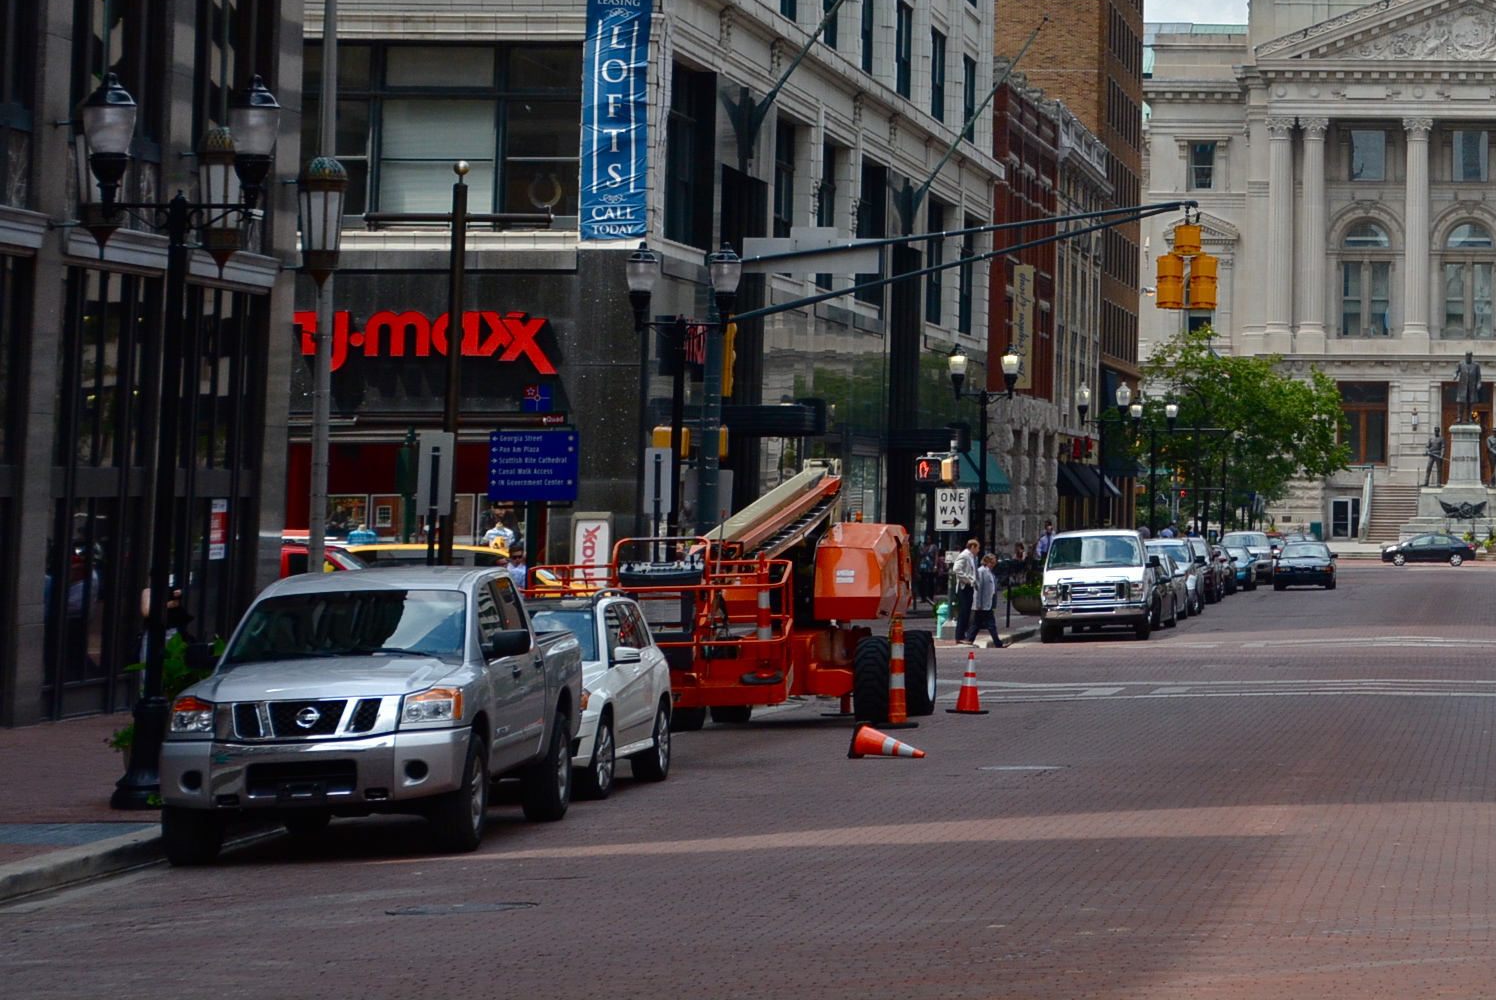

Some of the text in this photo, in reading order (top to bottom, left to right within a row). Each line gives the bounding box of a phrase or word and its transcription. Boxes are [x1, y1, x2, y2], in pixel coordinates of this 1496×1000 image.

[601, 25, 628, 187] LOFTS
[592, 206, 635, 220] CALL
[592, 224, 634, 235] TODAY
[499, 435, 523, 443] Georgia
[940, 492, 965, 502] ONE
[939, 505, 966, 515] WAY
